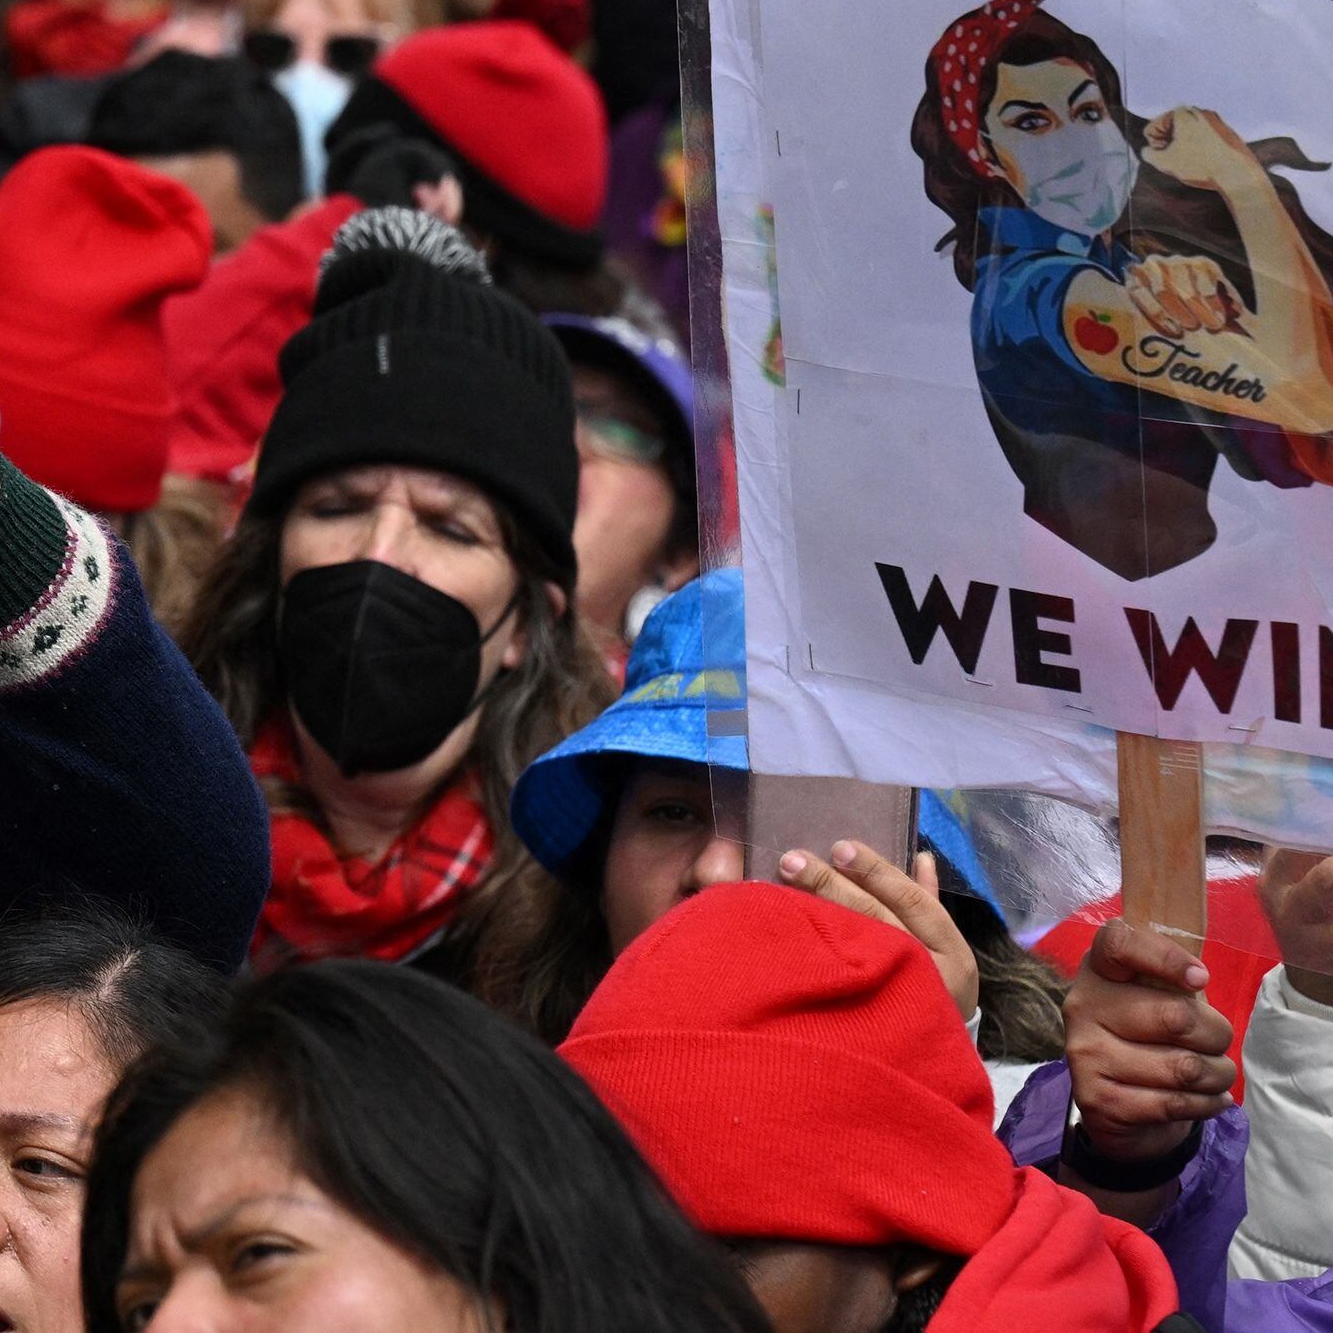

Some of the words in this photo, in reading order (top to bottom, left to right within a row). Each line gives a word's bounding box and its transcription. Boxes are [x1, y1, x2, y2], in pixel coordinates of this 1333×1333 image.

[1122, 335, 1267, 403] Teacher
[874, 561, 1081, 693] WE
[1123, 606, 1333, 729] WI
